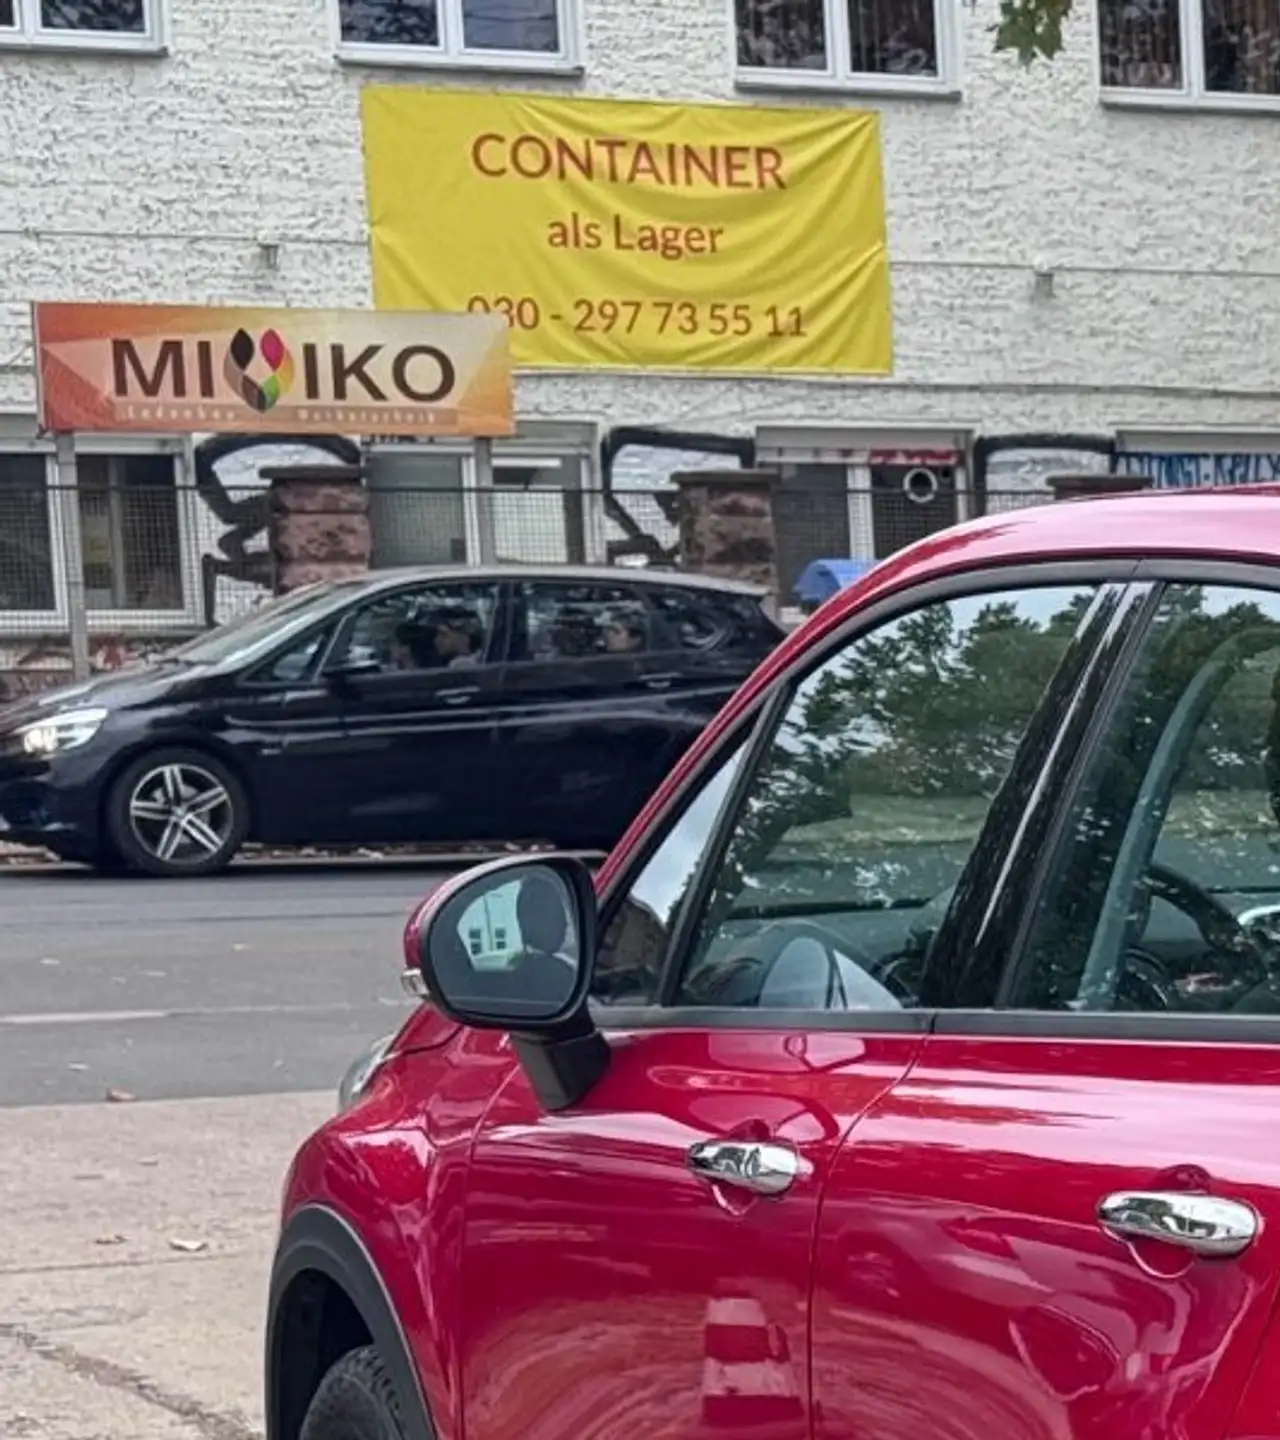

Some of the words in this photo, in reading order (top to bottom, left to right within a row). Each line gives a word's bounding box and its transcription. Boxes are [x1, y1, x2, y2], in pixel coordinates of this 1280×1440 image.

[471, 132, 788, 190] CONTAINER
[547, 212, 603, 249] als
[613, 213, 724, 260] Lager
